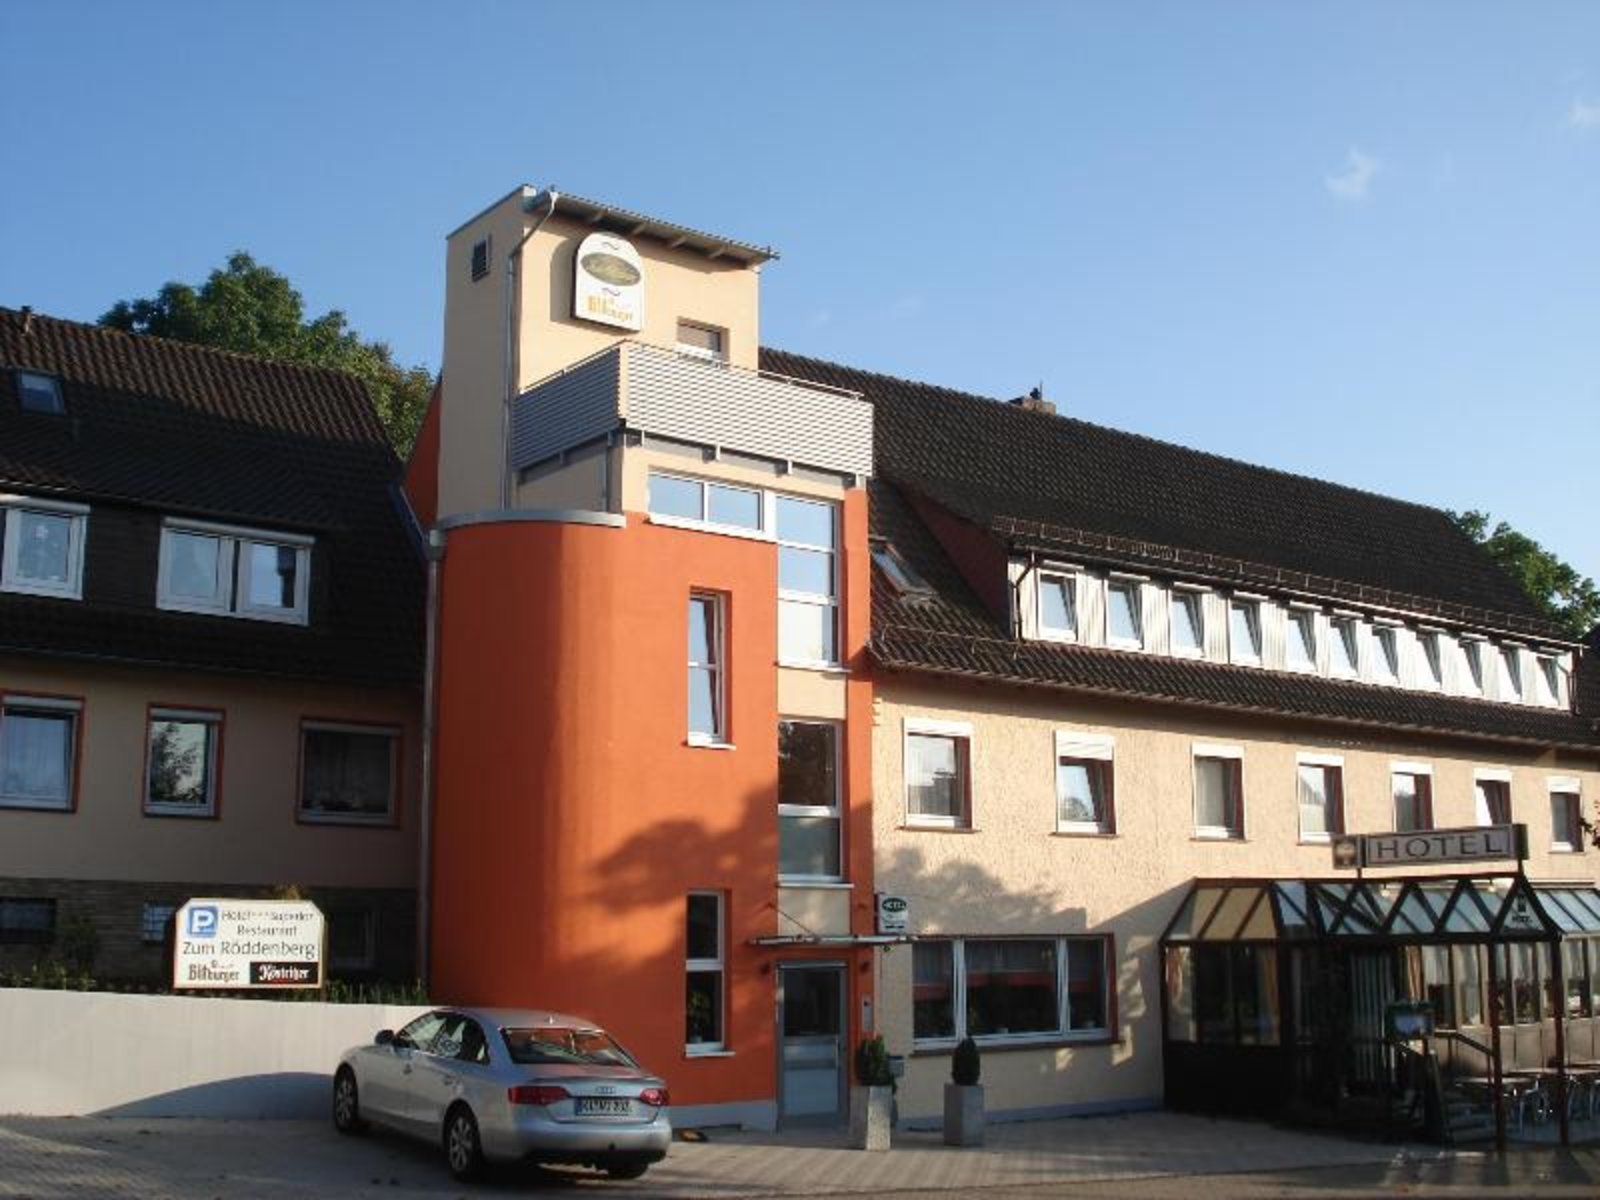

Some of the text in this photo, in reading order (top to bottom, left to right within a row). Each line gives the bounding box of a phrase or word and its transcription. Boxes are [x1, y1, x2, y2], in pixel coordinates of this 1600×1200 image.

[1376, 834, 1503, 858] HOTEL
[191, 909, 215, 933] P
[237, 925, 297, 936] Restaurant
[183, 941, 315, 960] Zum Röddenberg
